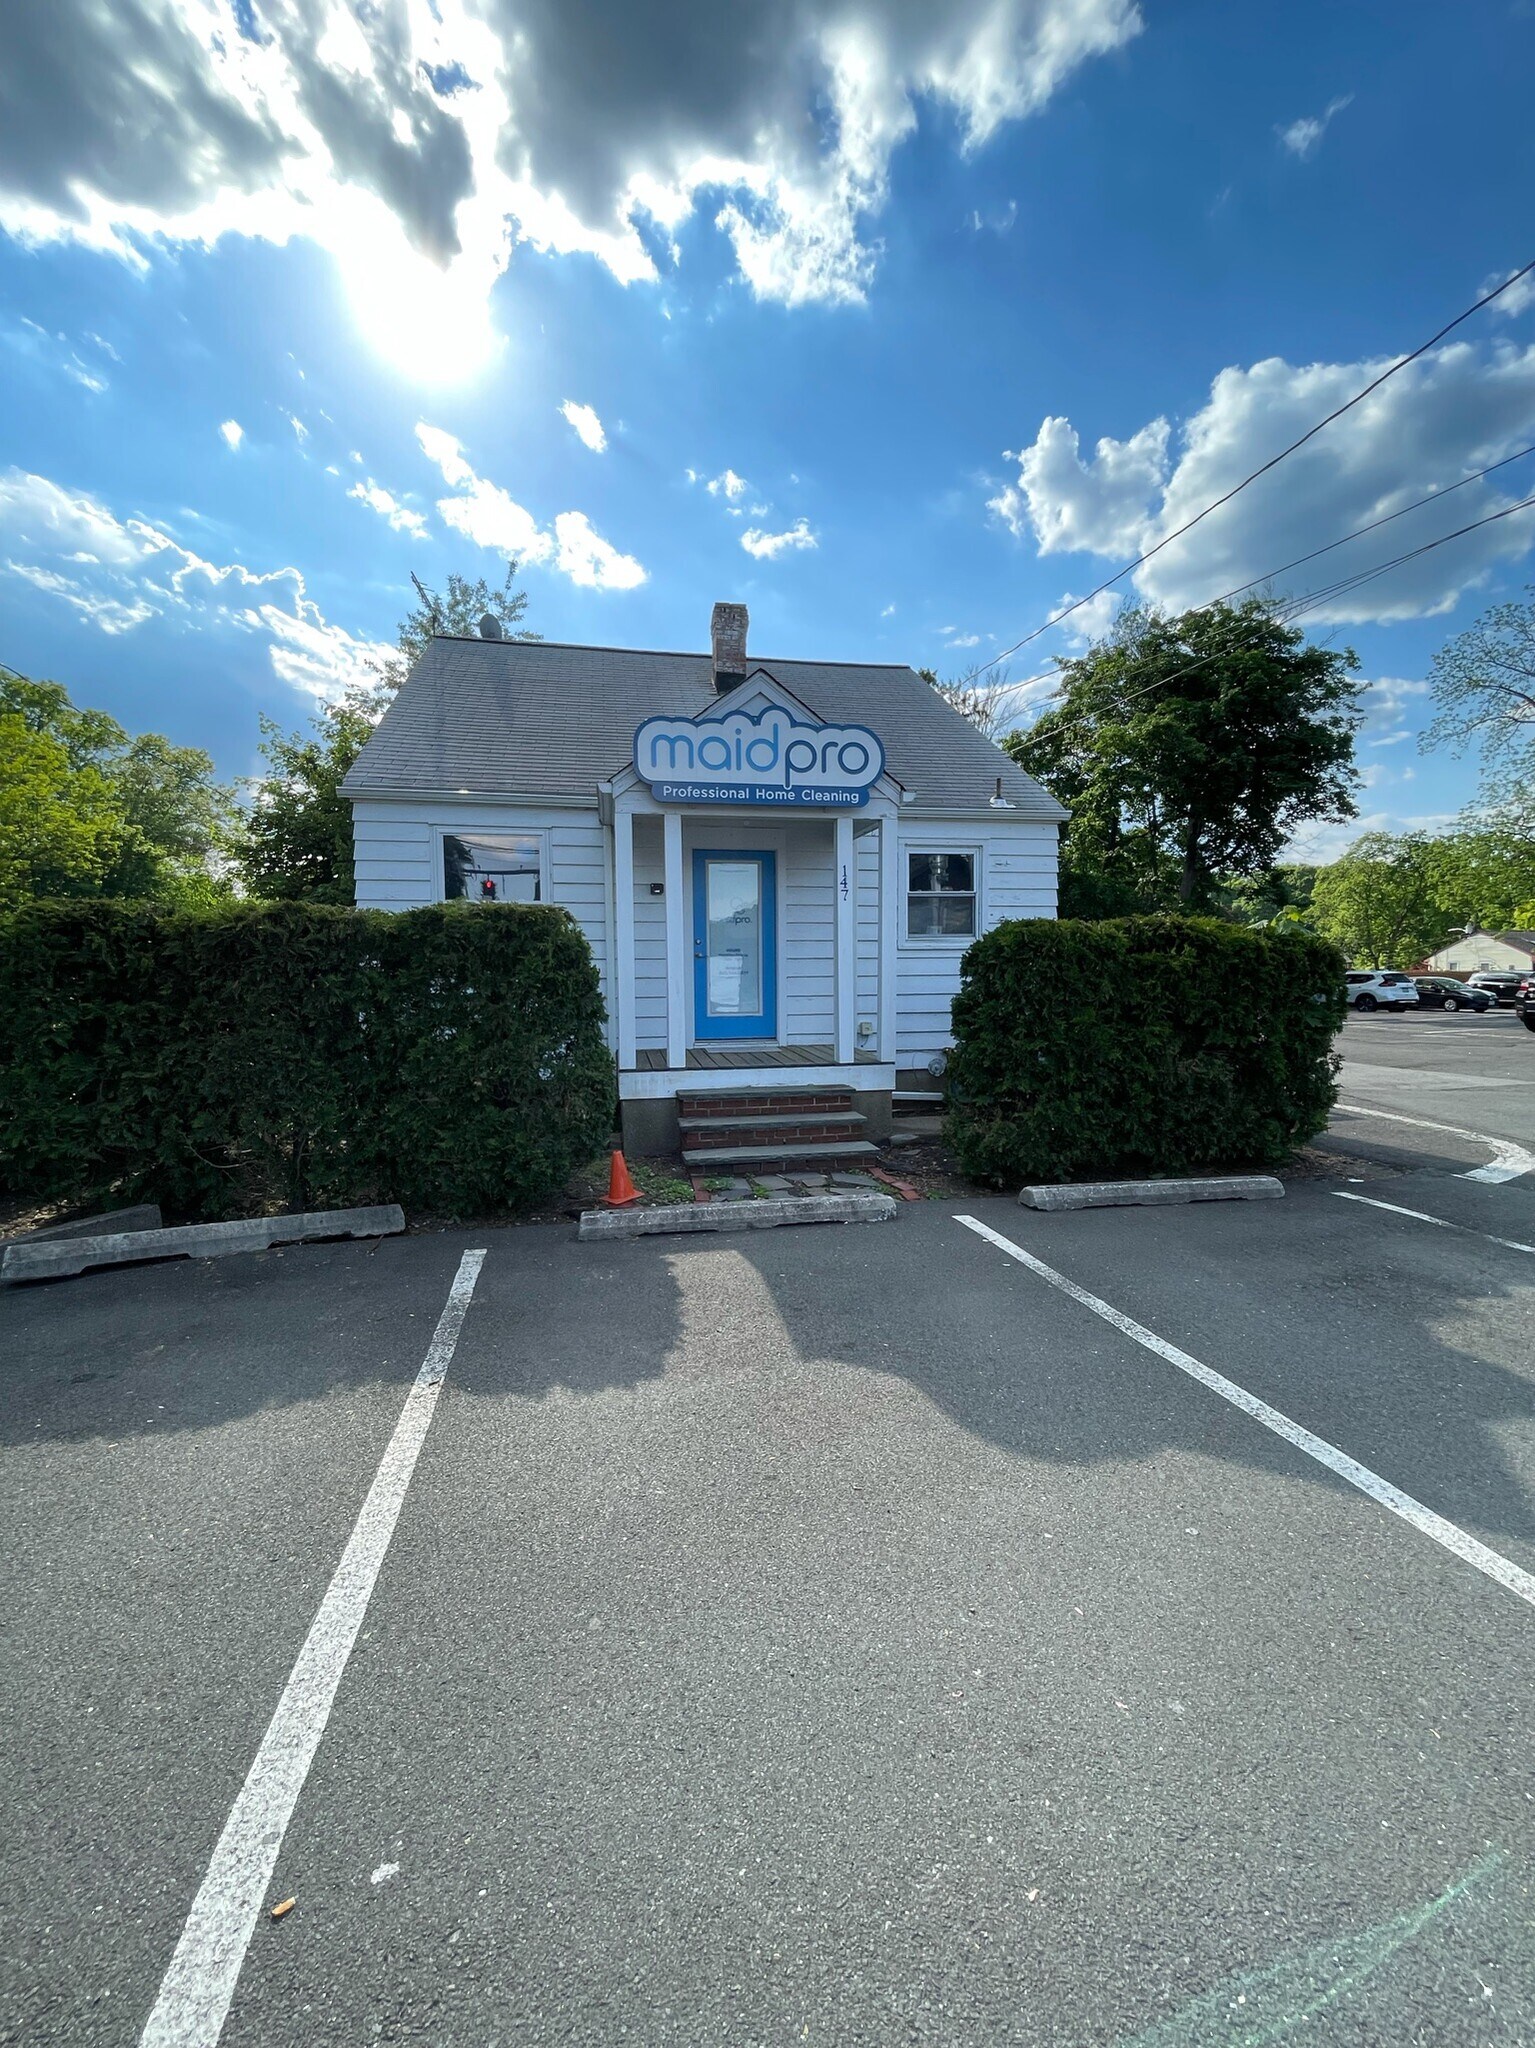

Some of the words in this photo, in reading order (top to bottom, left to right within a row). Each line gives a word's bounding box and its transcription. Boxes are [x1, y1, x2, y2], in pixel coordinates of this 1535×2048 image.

[651, 723, 869, 788] maidpro
[663, 785, 749, 799] Professional
[756, 788, 796, 800] Home
[801, 789, 859, 804] Cleaning
[840, 865, 849, 901] 147
